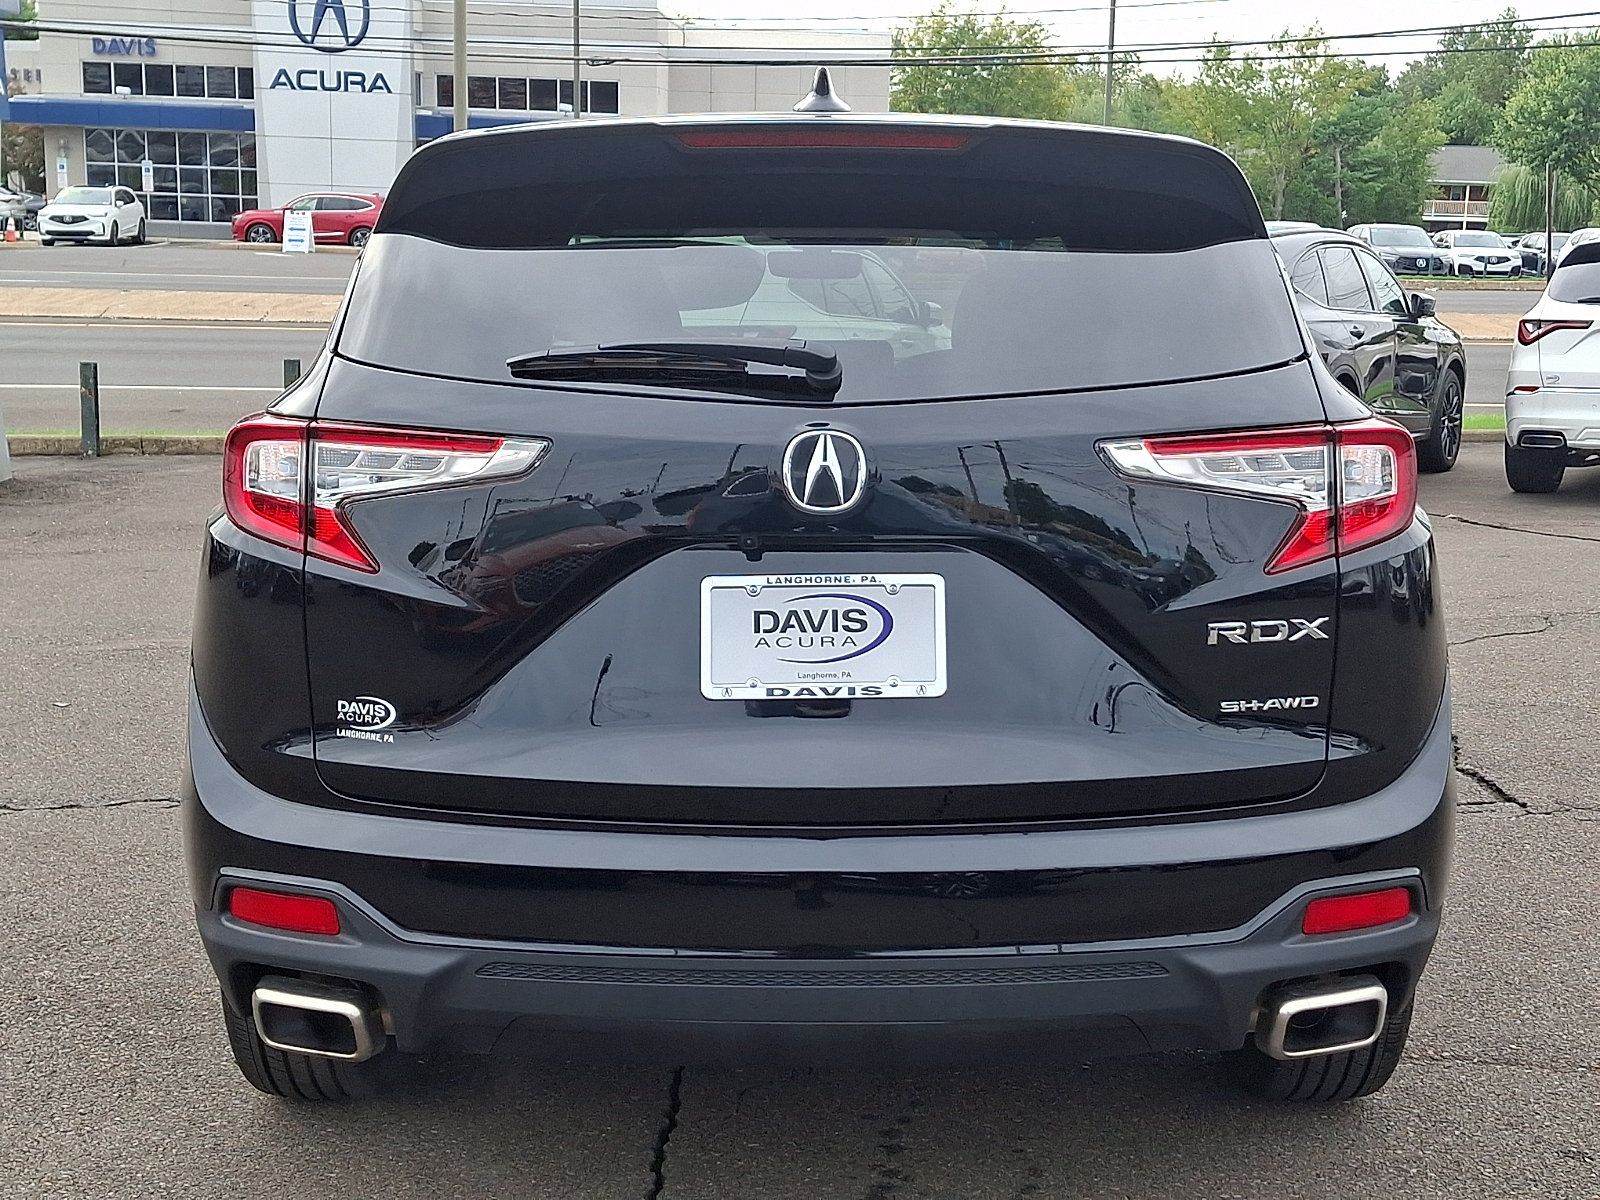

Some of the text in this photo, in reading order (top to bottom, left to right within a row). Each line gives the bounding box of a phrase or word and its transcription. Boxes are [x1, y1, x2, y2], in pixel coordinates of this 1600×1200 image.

[92, 37, 156, 57] DAVIS
[269, 68, 393, 93] ACURA
[753, 608, 869, 634] DAVIS
[1206, 616, 1329, 645] RDX
[754, 636, 858, 648] ACURA
[797, 671, 852, 680] Langhorne, PA
[766, 686, 883, 697] DAVIS
[337, 700, 386, 717] DAVIS
[1220, 696, 1320, 713] SH-AWD
[337, 711, 381, 724] ACURA
[383, 734, 394, 743] PA
